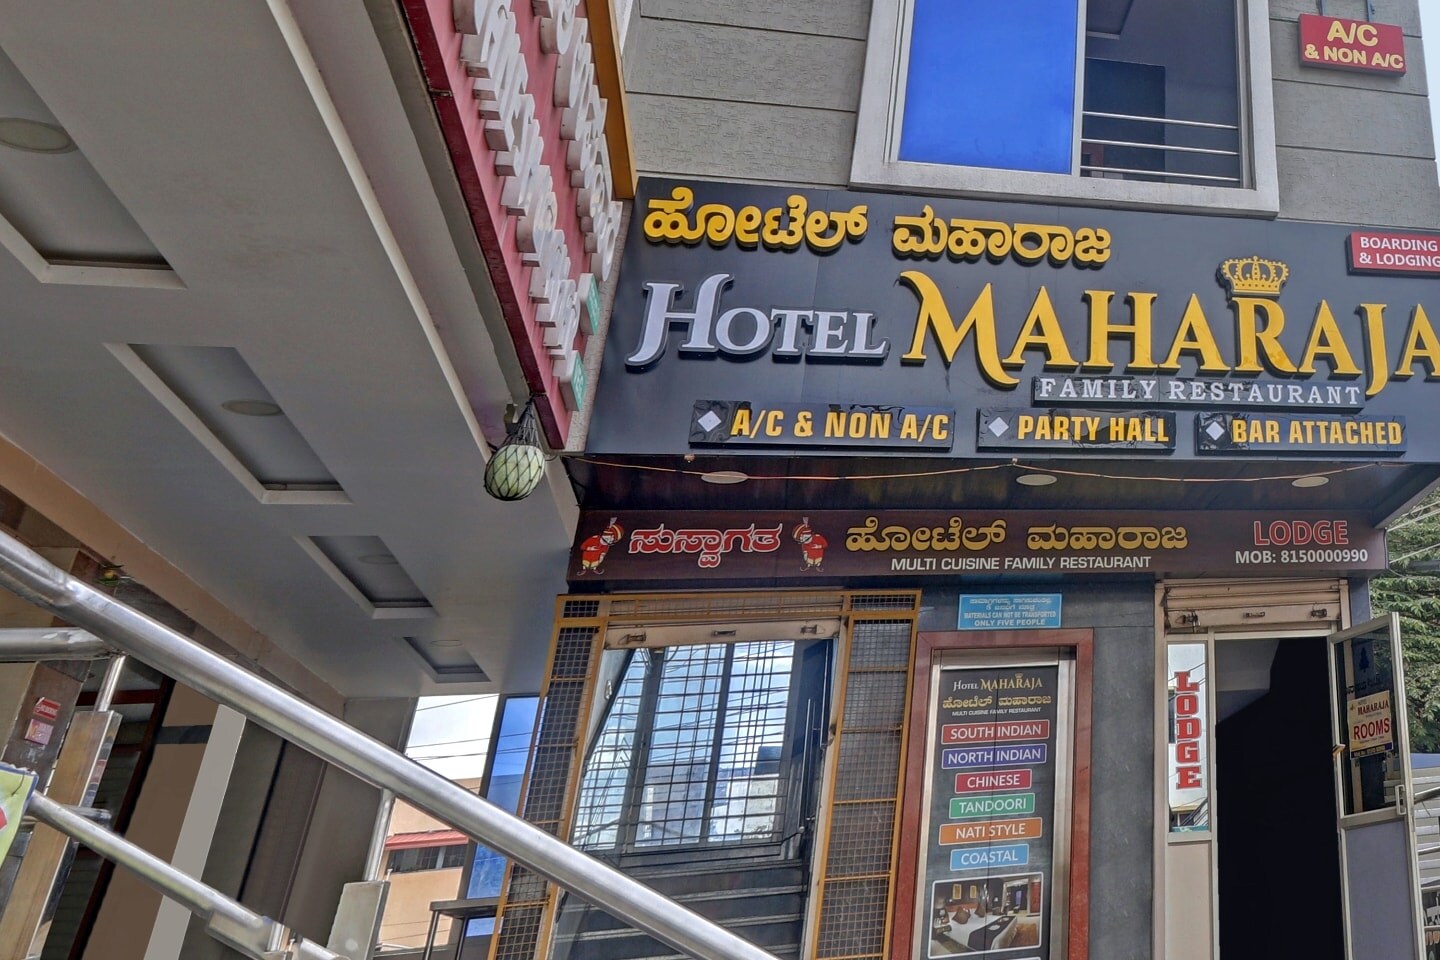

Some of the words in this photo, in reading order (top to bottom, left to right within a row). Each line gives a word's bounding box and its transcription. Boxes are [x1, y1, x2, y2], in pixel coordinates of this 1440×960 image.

[1326, 19, 1379, 47] A/C
[1304, 44, 1320, 60] &
[1323, 46, 1367, 65] NON
[1370, 51, 1404, 70] A/C
[643, 187, 868, 253] ಹೋಟೆಲ್
[892, 204, 1111, 266] ಮಹಾರಾಜ
[1359, 235, 1438, 253] BOARDING
[1359, 251, 1373, 266] &
[625, 273, 890, 370] HOTEL
[1040, 377, 1157, 401] FAMILY
[1168, 380, 1362, 407] RESTAURANT
[730, 409, 783, 438] A/C
[793, 411, 814, 438] &
[825, 412, 891, 440] NON
[900, 414, 949, 442] A/C
[1016, 414, 1101, 441] PARTY
[1108, 417, 1170, 443] HALL
[1233, 419, 1283, 444] BAR
[1289, 420, 1402, 446] ATTACHED
[845, 517, 1007, 553] ಹೋಟೆಲ್
[1026, 523, 1188, 551] ಮಹಾರಾಜ
[1252, 519, 1349, 547] LODGE
[890, 556, 936, 571] MULTI
[940, 556, 1000, 571] CUISINE
[1004, 556, 1057, 570] FAMILY
[1060, 555, 1151, 570] RESTAURANT
[1235, 549, 1277, 565] MOB:
[1280, 547, 1369, 564] 8150000990
[974, 619, 995, 627] ONLY
[980, 678, 1043, 692] MAHARAJA
[1357, 699, 1389, 716] MAHARAJA
[950, 727, 994, 740] SOUTH
[997, 724, 1042, 737] INDIAN
[1173, 670, 1203, 790] LODGE
[1353, 717, 1390, 740] ROOMS
[947, 750, 994, 765] NORTH
[996, 747, 1042, 762] INDIAN
[966, 773, 1021, 789] CHINESE
[958, 797, 1027, 814] TANDOORI
[955, 825, 986, 840] NATI
[988, 822, 1026, 837] STYLE
[960, 848, 1019, 866] COASTAL
